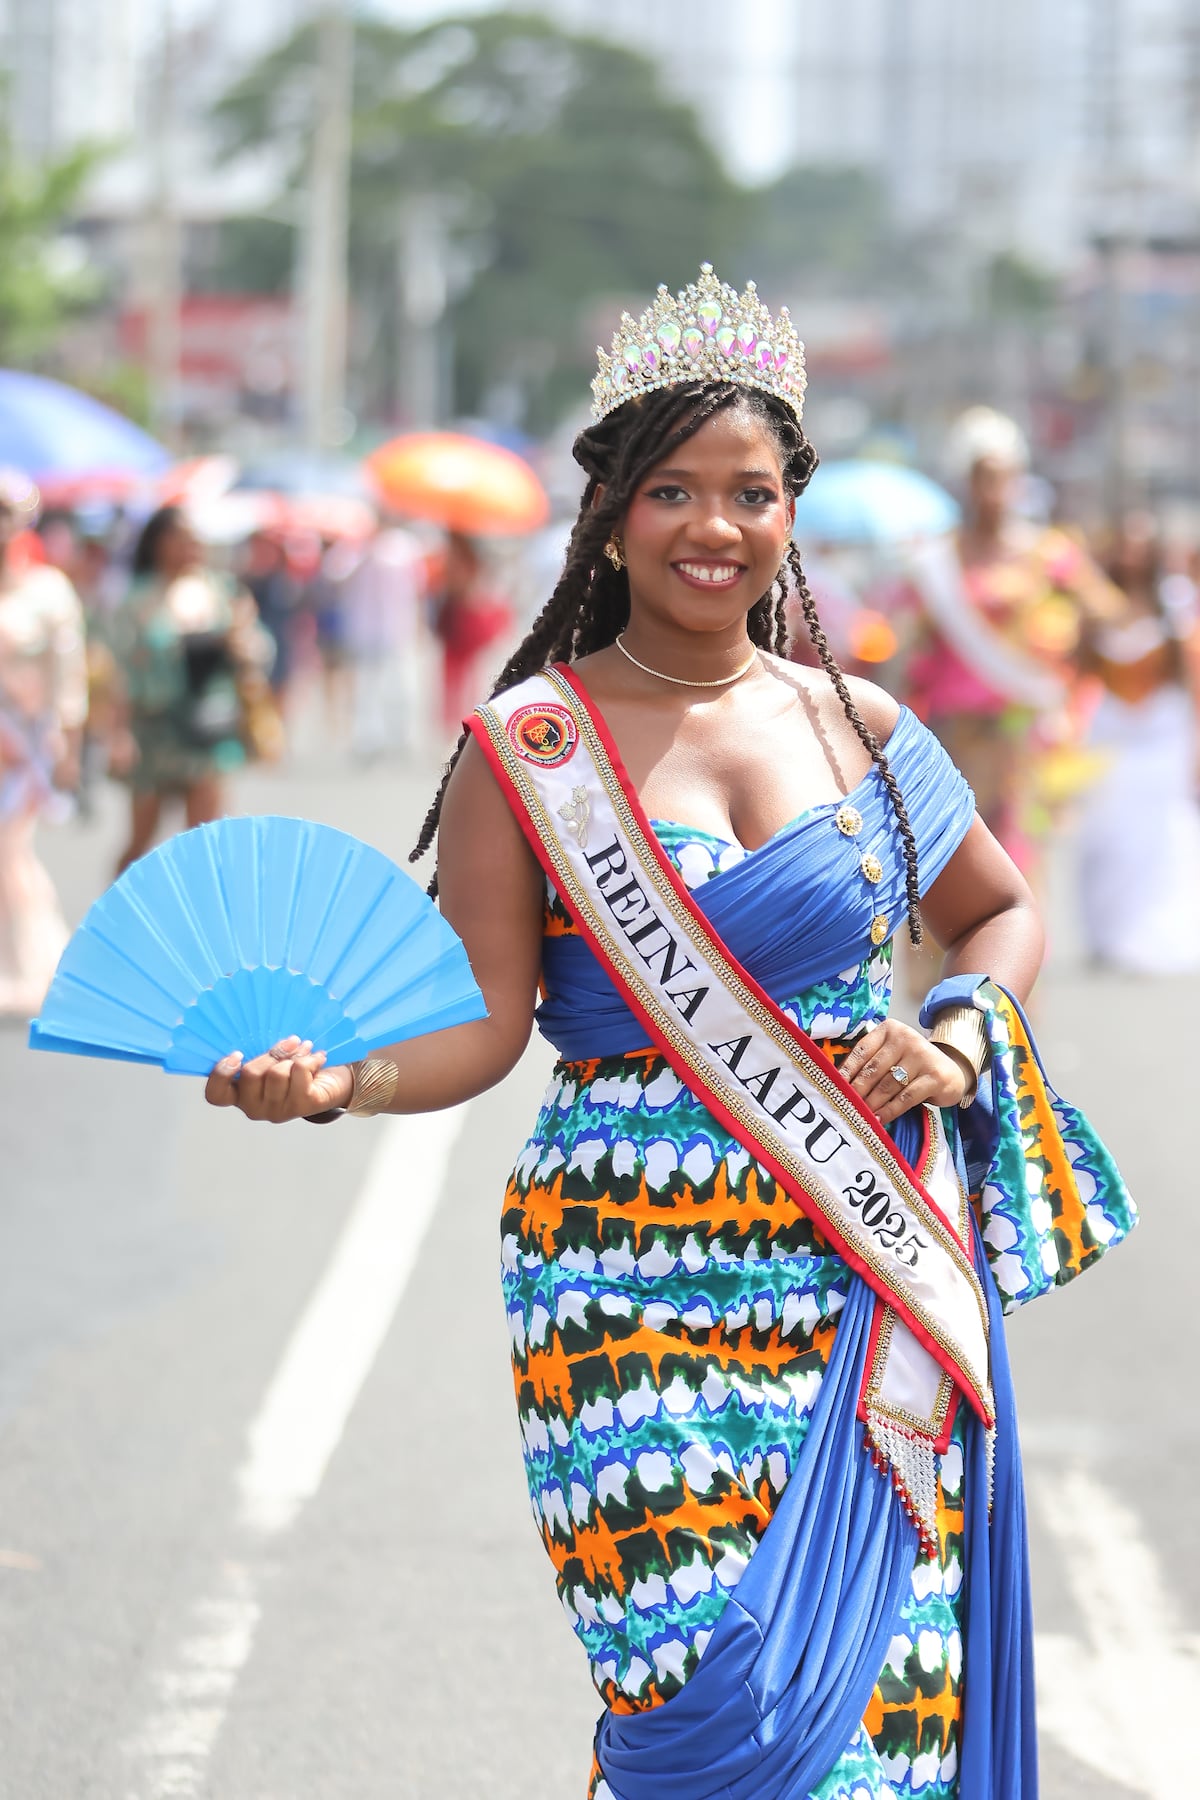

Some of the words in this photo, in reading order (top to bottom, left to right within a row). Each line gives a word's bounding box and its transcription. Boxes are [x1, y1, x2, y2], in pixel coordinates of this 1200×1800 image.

[582, 833, 709, 1027] REINA
[707, 1035, 851, 1163] AAPU
[842, 1170, 928, 1266] 2025
